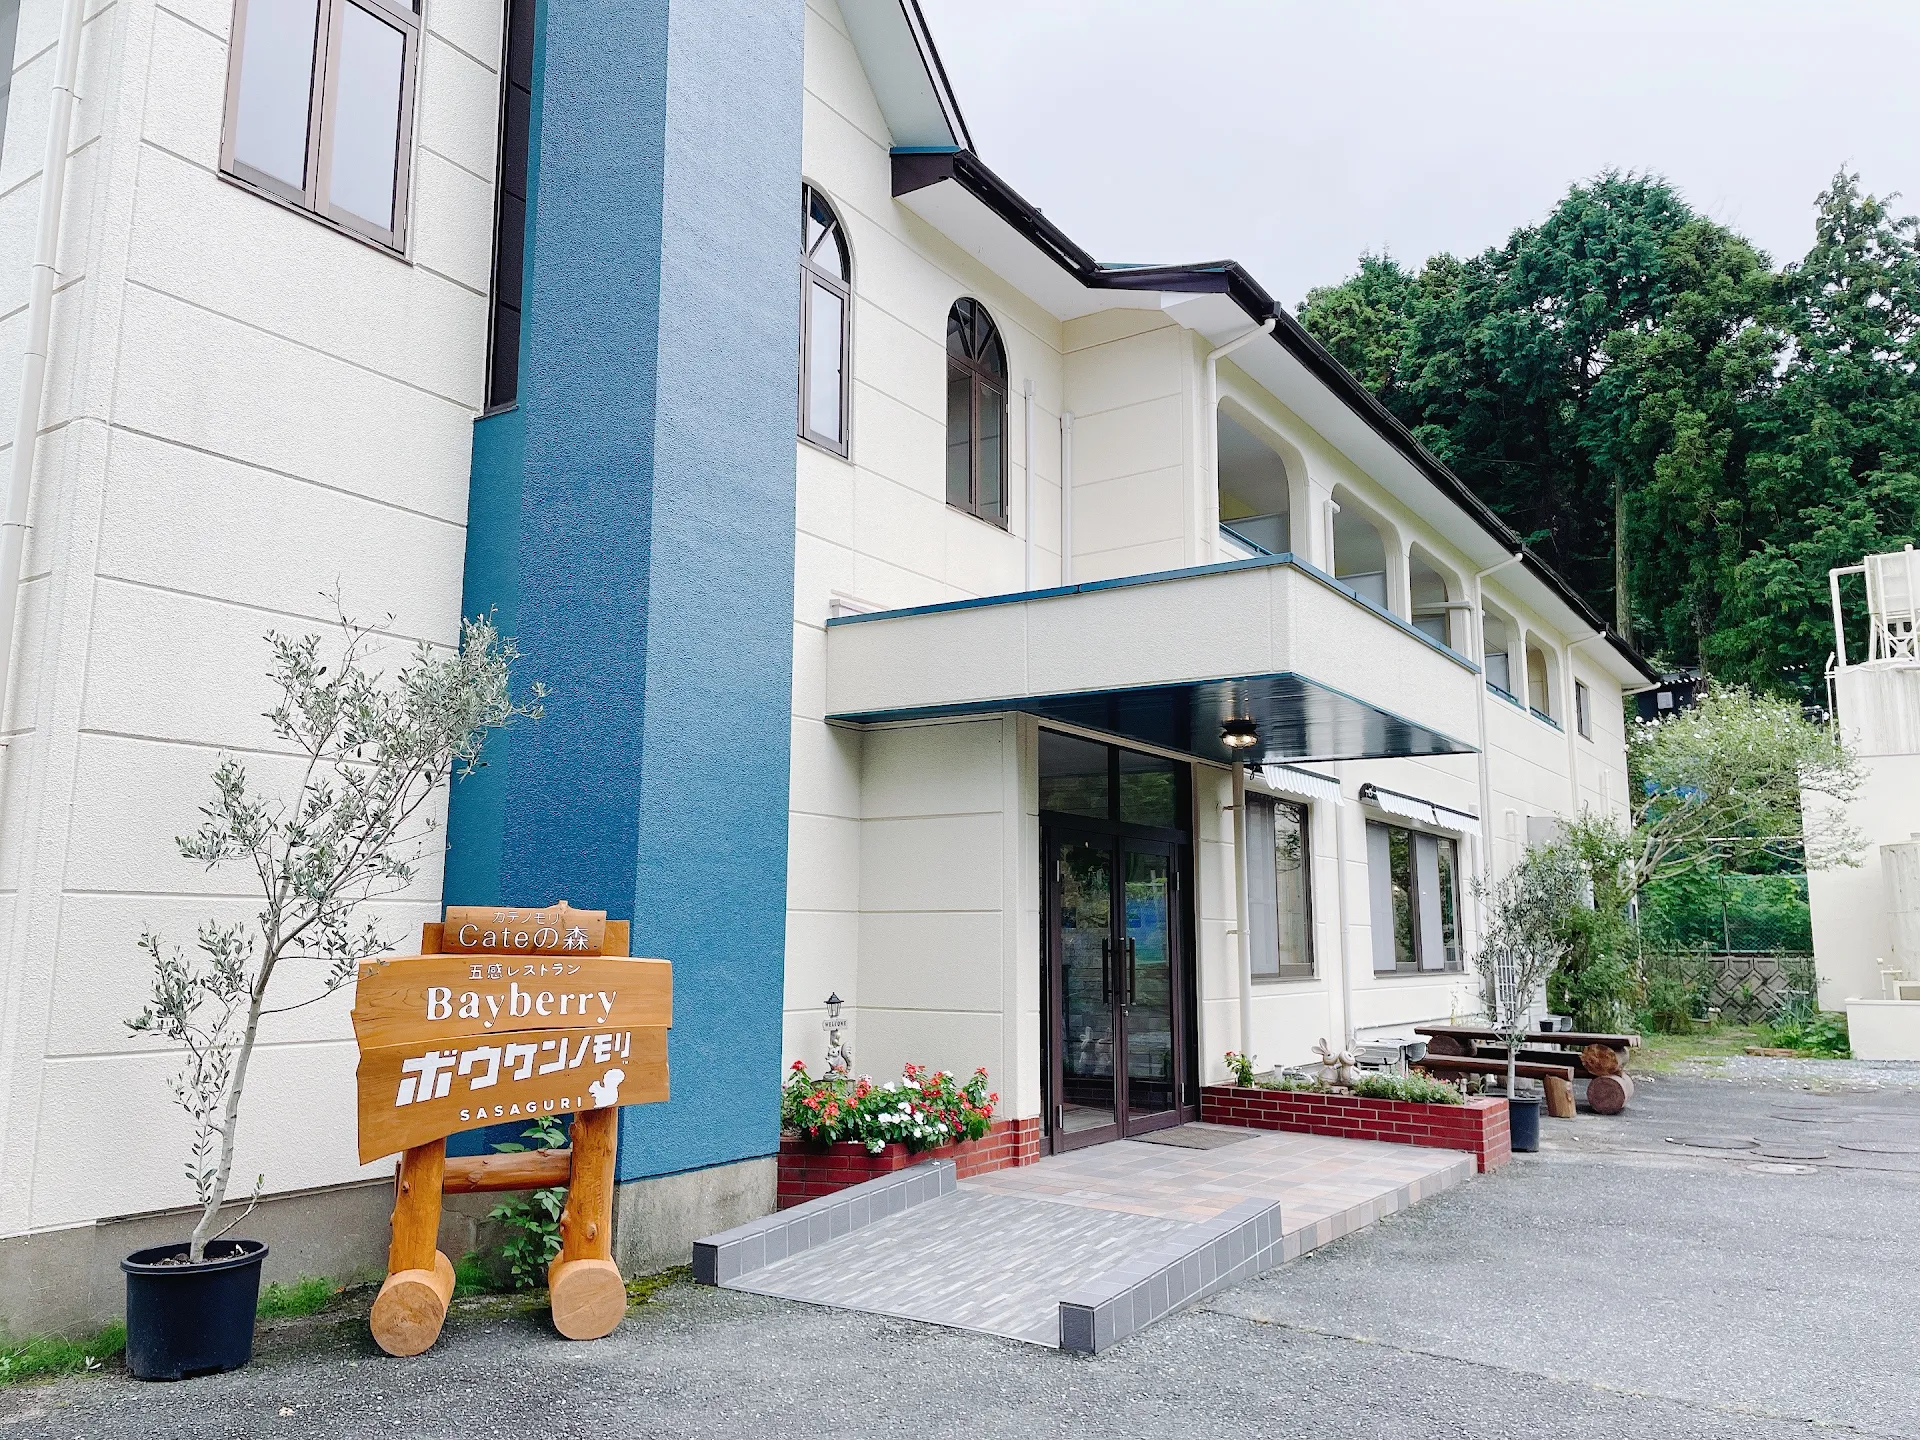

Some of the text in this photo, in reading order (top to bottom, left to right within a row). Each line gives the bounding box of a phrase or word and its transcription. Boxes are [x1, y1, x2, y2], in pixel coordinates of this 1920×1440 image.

[492, 911, 560, 924] カテノモリ
[459, 924, 589, 951] Cateの森
[468, 963, 581, 980] 五感レストラン
[426, 982, 617, 1028] Bayberry
[394, 1031, 631, 1107] ボウケンノモリ
[460, 1096, 583, 1121] SASAGURI
